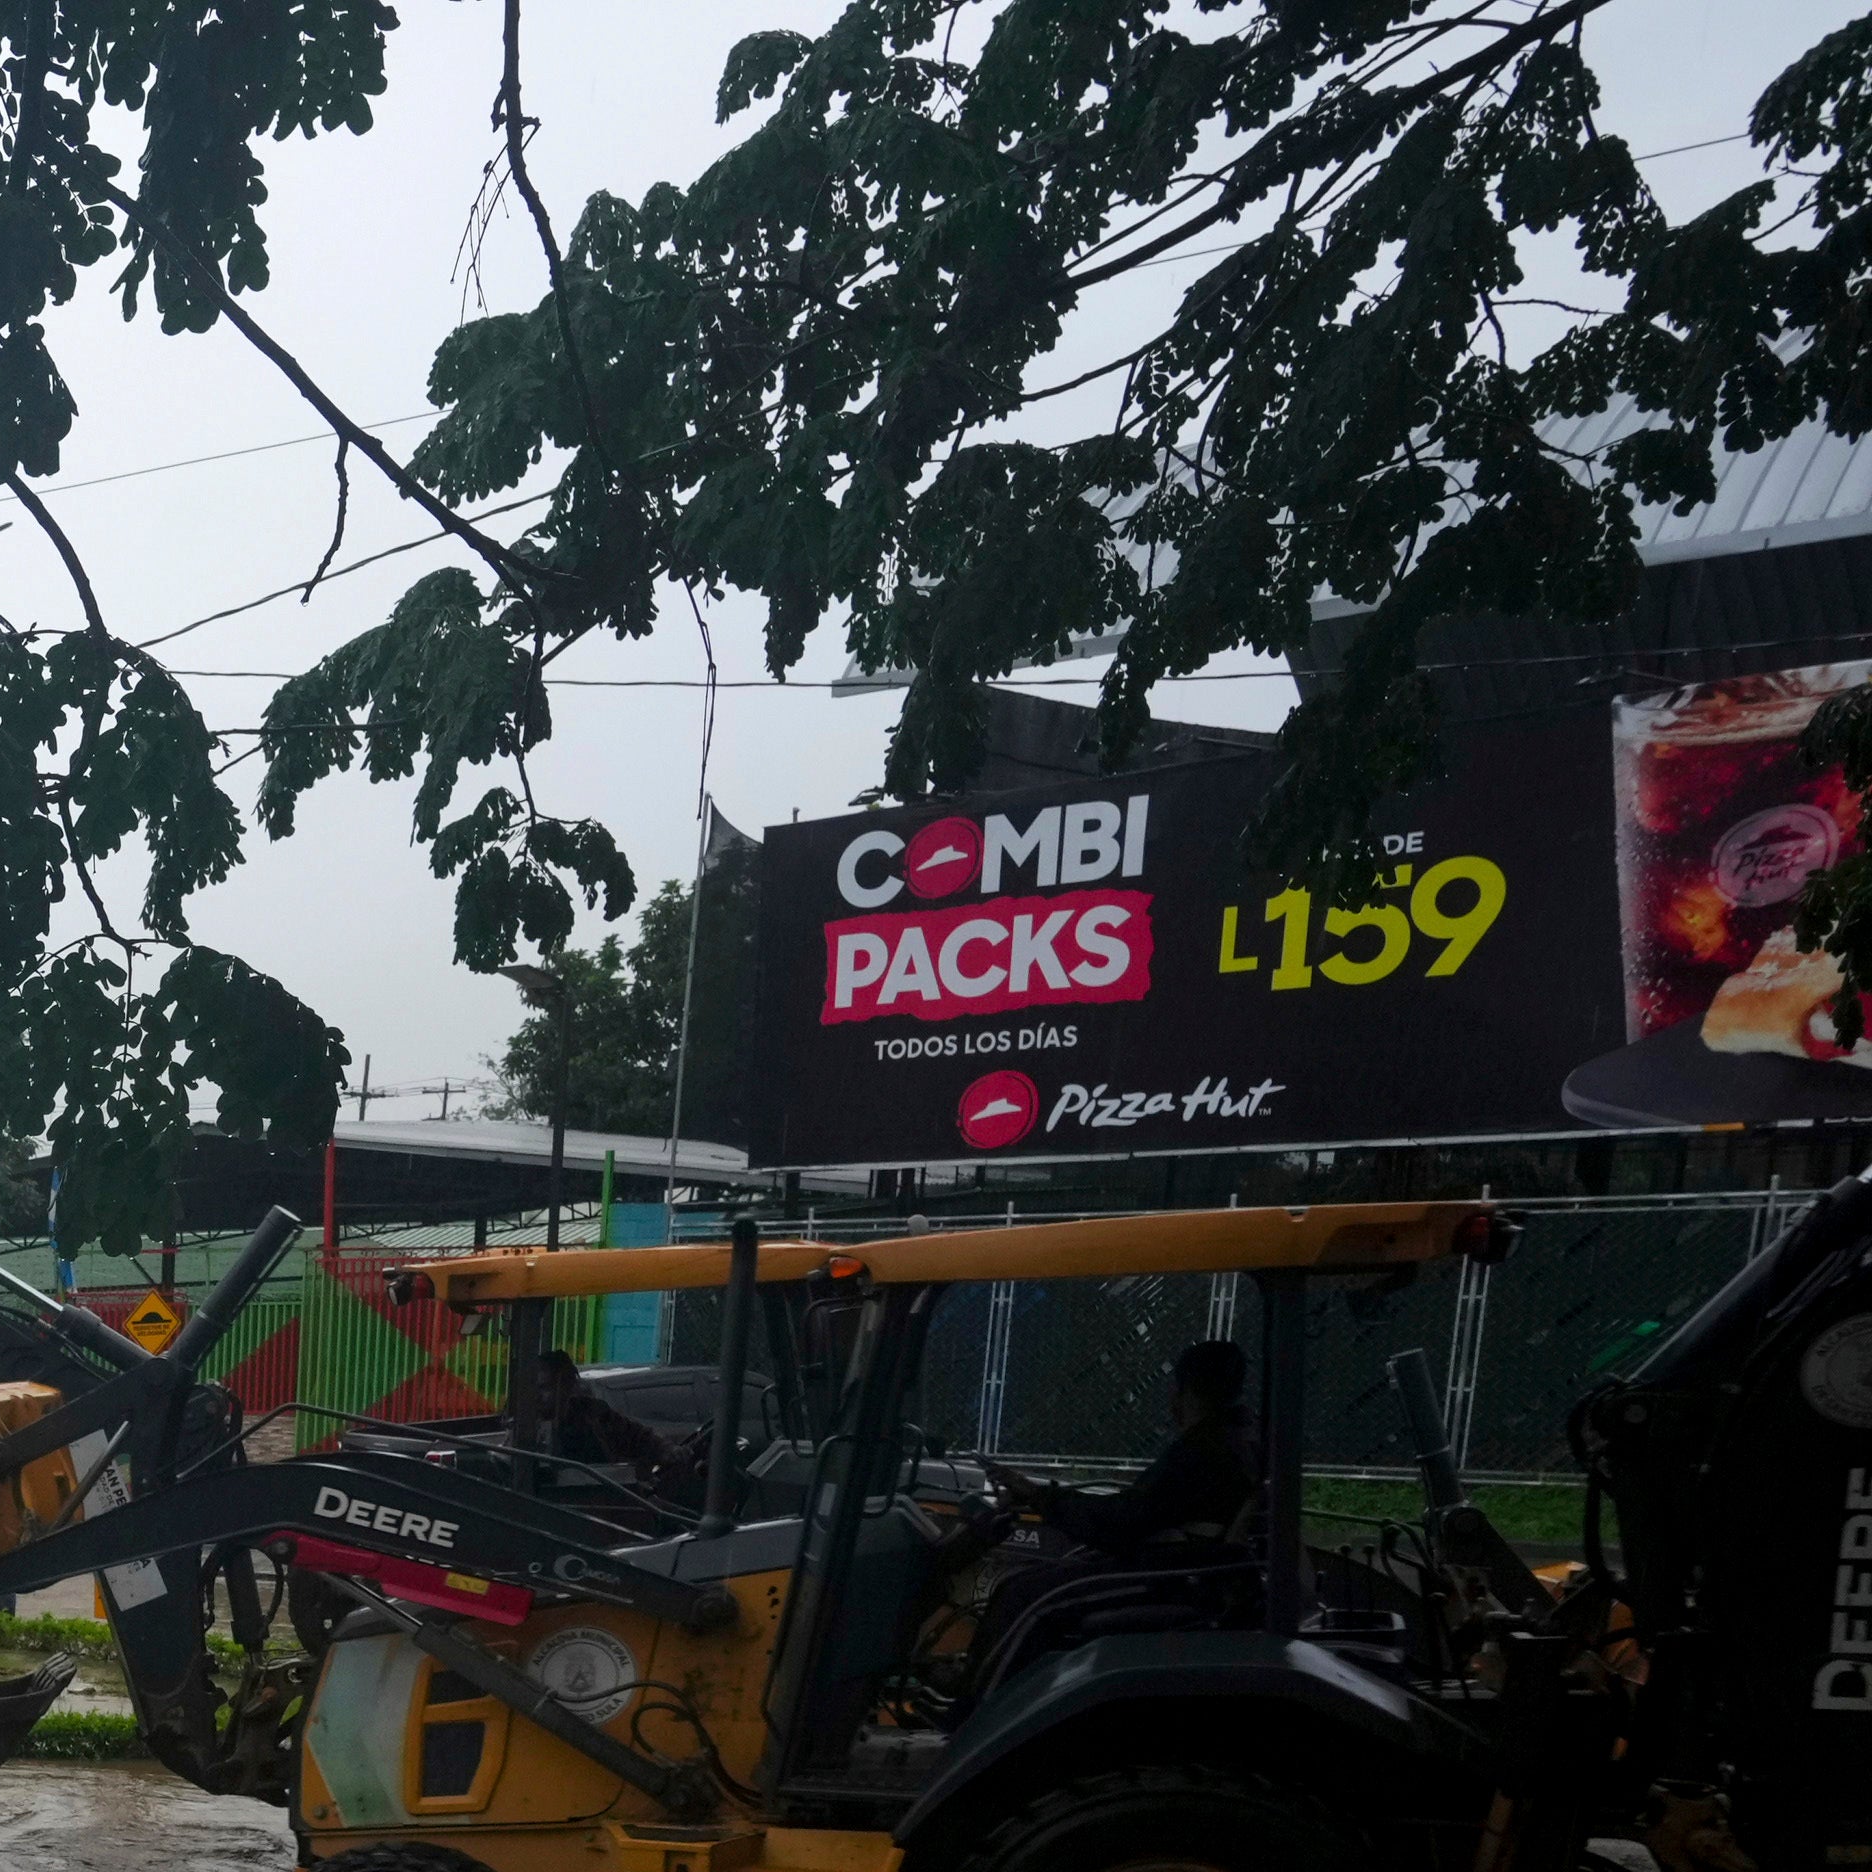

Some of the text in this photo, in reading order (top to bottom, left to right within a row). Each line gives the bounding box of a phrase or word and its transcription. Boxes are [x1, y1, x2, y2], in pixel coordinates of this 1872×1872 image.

[834, 905, 1131, 1008] PACKS
[874, 1022, 1078, 1060] TODOS LOS DÍAS
[1046, 1083, 1176, 1132] Pizza
[1181, 1076, 1286, 1122] Hut
[313, 1486, 460, 1548] DEERE
